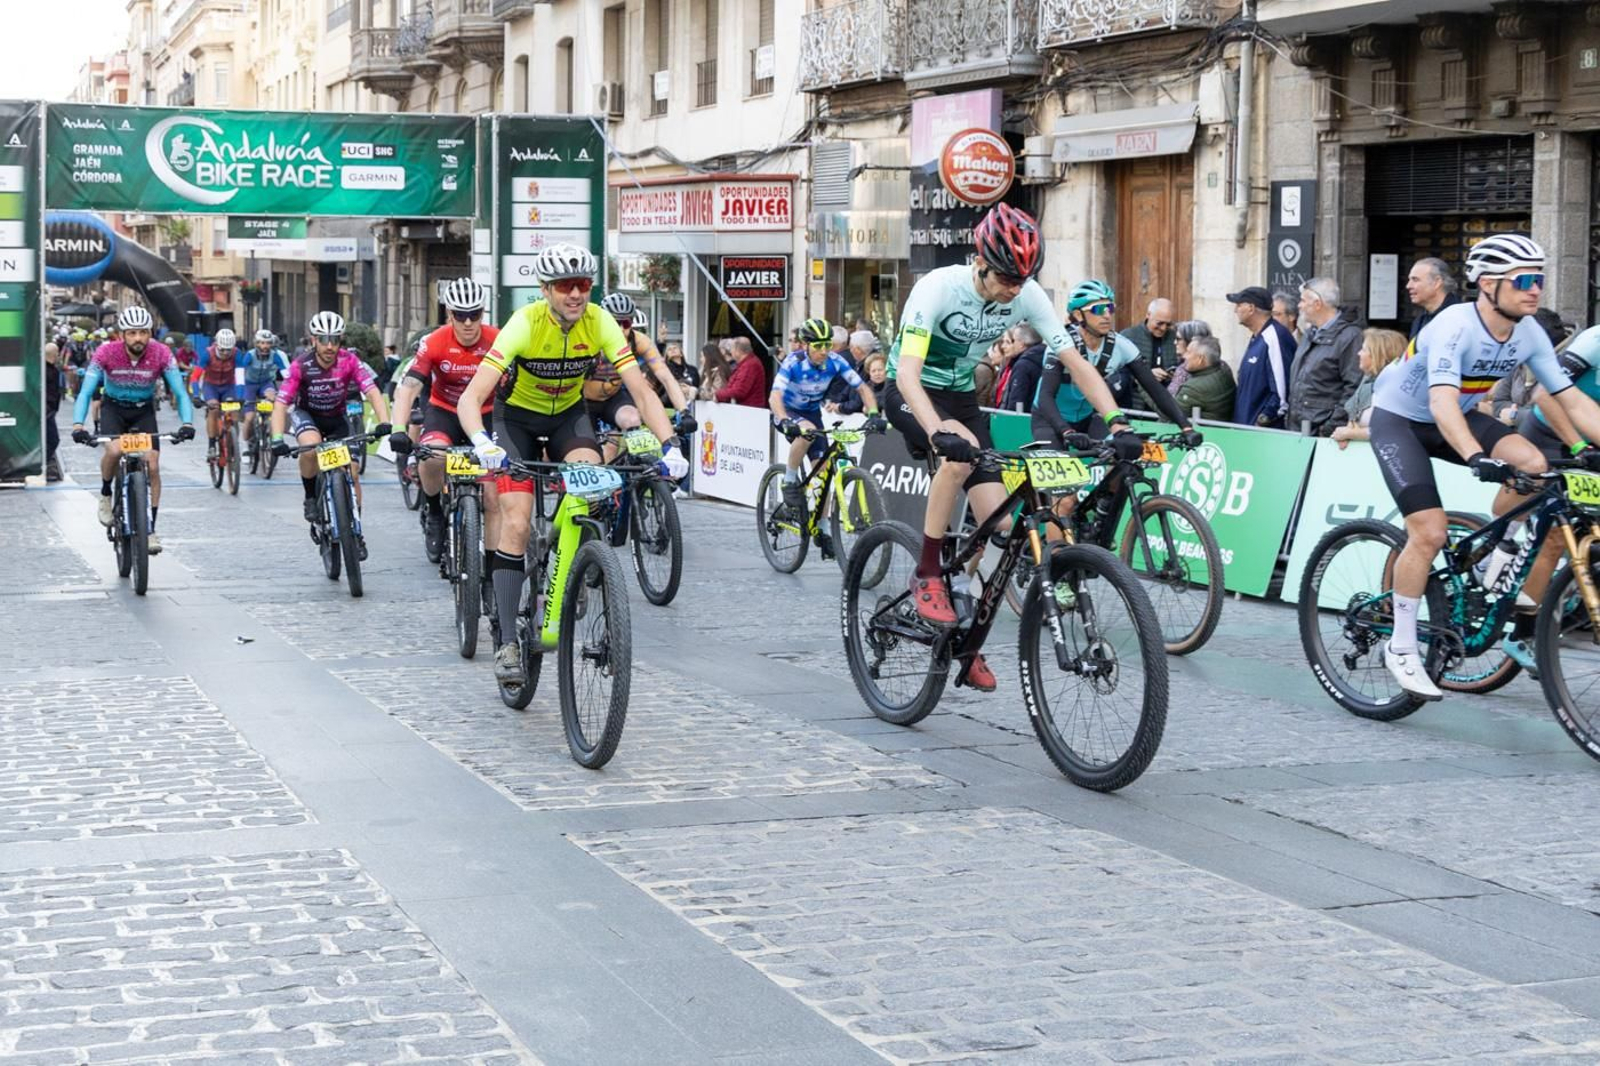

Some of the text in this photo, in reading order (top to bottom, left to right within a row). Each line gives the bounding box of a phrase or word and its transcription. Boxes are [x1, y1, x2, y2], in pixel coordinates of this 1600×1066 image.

[73, 144, 123, 156] GRANADA
[195, 129, 332, 165] Andalucía
[347, 146, 370, 155] UCI
[510, 147, 562, 161] Andalucía
[73, 156, 101, 169] JAÉN
[952, 154, 1009, 173] Mahou
[73, 170, 122, 183] CÓRDOBA
[196, 162, 333, 188] BIKE RACE
[348, 173, 398, 182] GARMIN
[720, 187, 789, 198] OPORTUNIDADES
[910, 184, 924, 210] el
[622, 191, 677, 214] OPORTUNIDADES
[680, 190, 713, 226] JAVIER
[721, 199, 789, 217] JAVIER
[244, 221, 279, 229] STAGE
[622, 215, 678, 226] TODO EN TELAS
[721, 217, 745, 225] TODO
[763, 216, 789, 225] TELAS
[44, 239, 104, 252] ARMIN
[724, 258, 786, 269] OPORTUNIDADES
[728, 271, 780, 285] JAVIER
[727, 289, 784, 297] TODO EN TELAS
[526, 361, 560, 371] STEVEN
[123, 435, 150, 449] 510-1
[321, 449, 348, 467] 223-1
[720, 443, 765, 463] AYUNTAMIENTO
[720, 459, 728, 470] DE
[1032, 456, 1084, 483] 334-1
[569, 467, 616, 488] 408-1
[869, 462, 931, 497] GARM
[1146, 533, 1179, 553] SPOT
[1021, 660, 1039, 716] MAXXIS
[1313, 663, 1345, 700] MAXXIS
